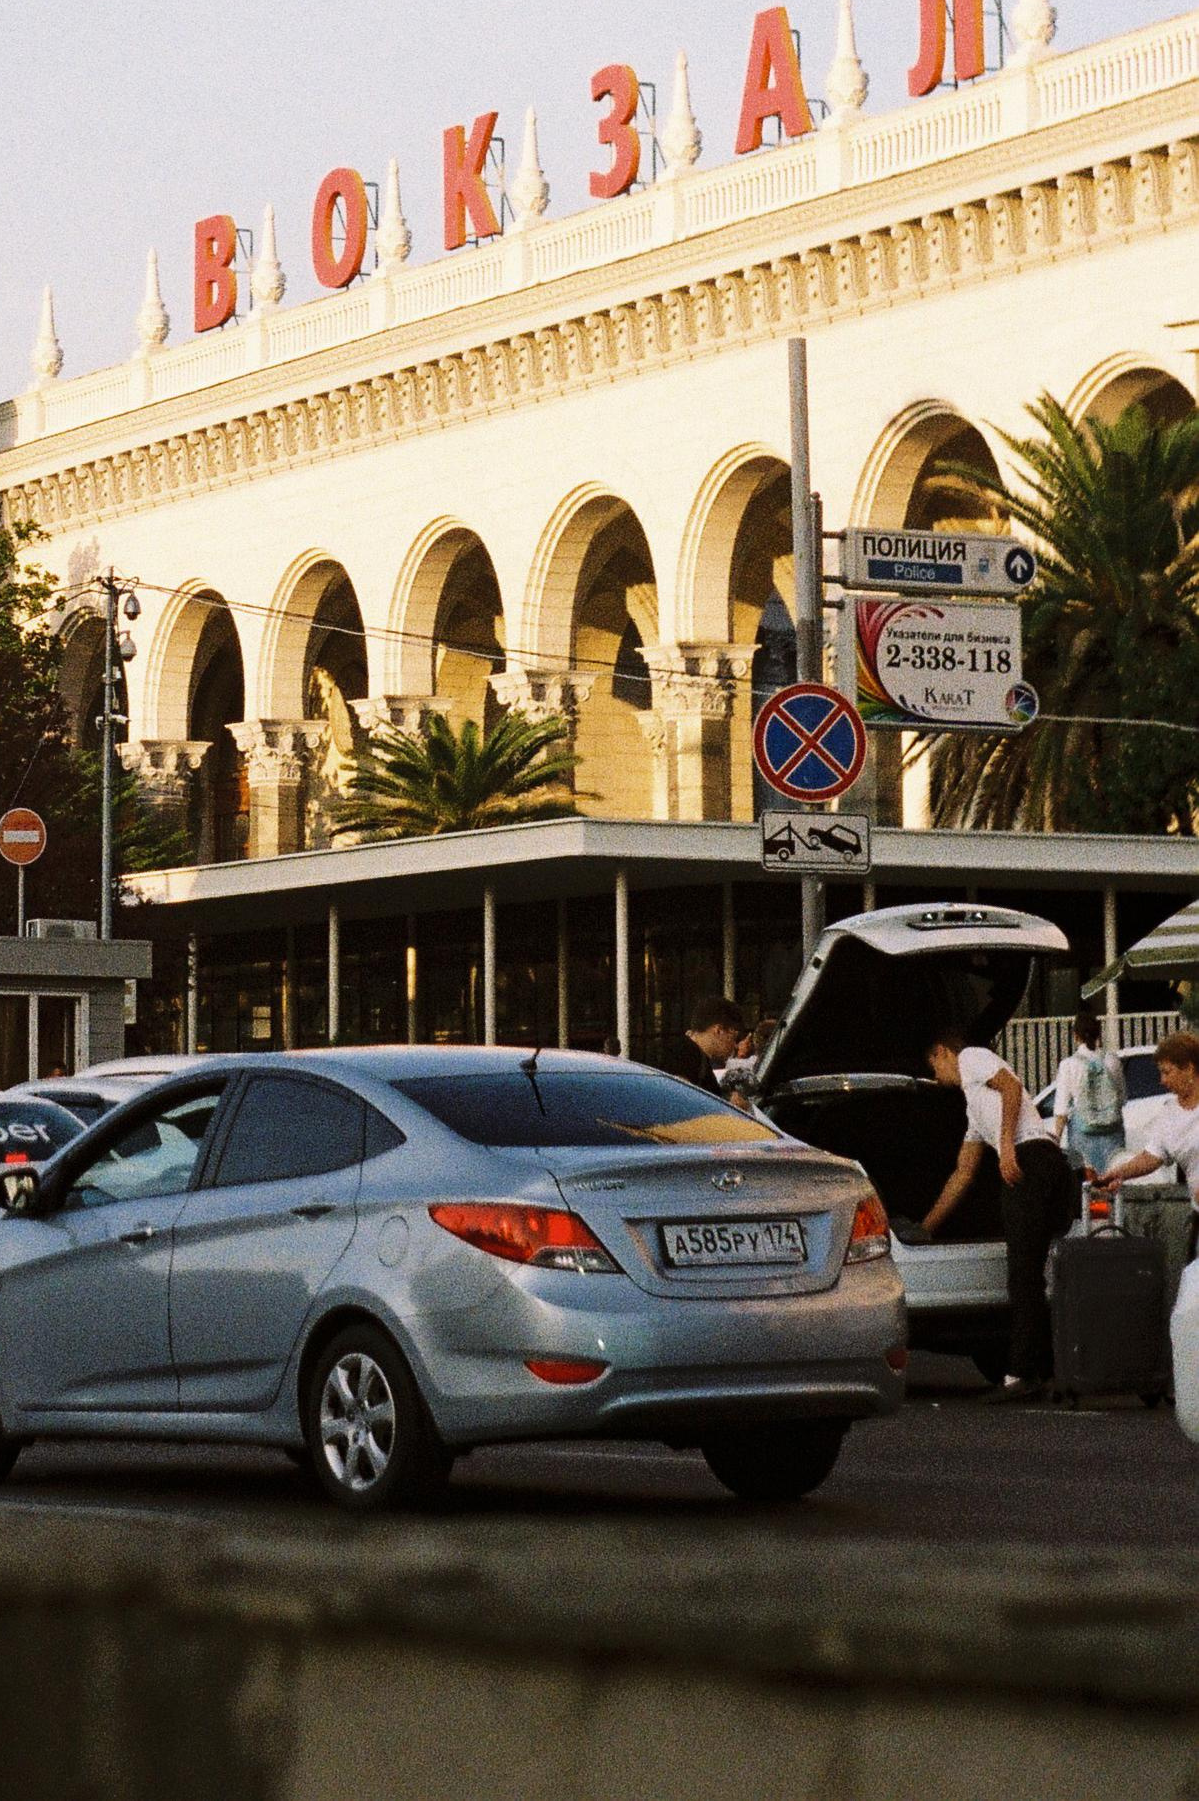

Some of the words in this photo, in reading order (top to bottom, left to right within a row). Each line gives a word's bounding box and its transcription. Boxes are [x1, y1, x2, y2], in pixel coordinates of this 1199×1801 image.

[863, 536, 967, 562] ПОЛИЦИЯ
[894, 563, 936, 580] Police
[886, 627, 941, 640] Указатели
[943, 633, 965, 644] для
[967, 631, 1011, 645] бизнеса
[886, 644, 1012, 674] 2-338-118
[765, 1224, 798, 1245] 174
